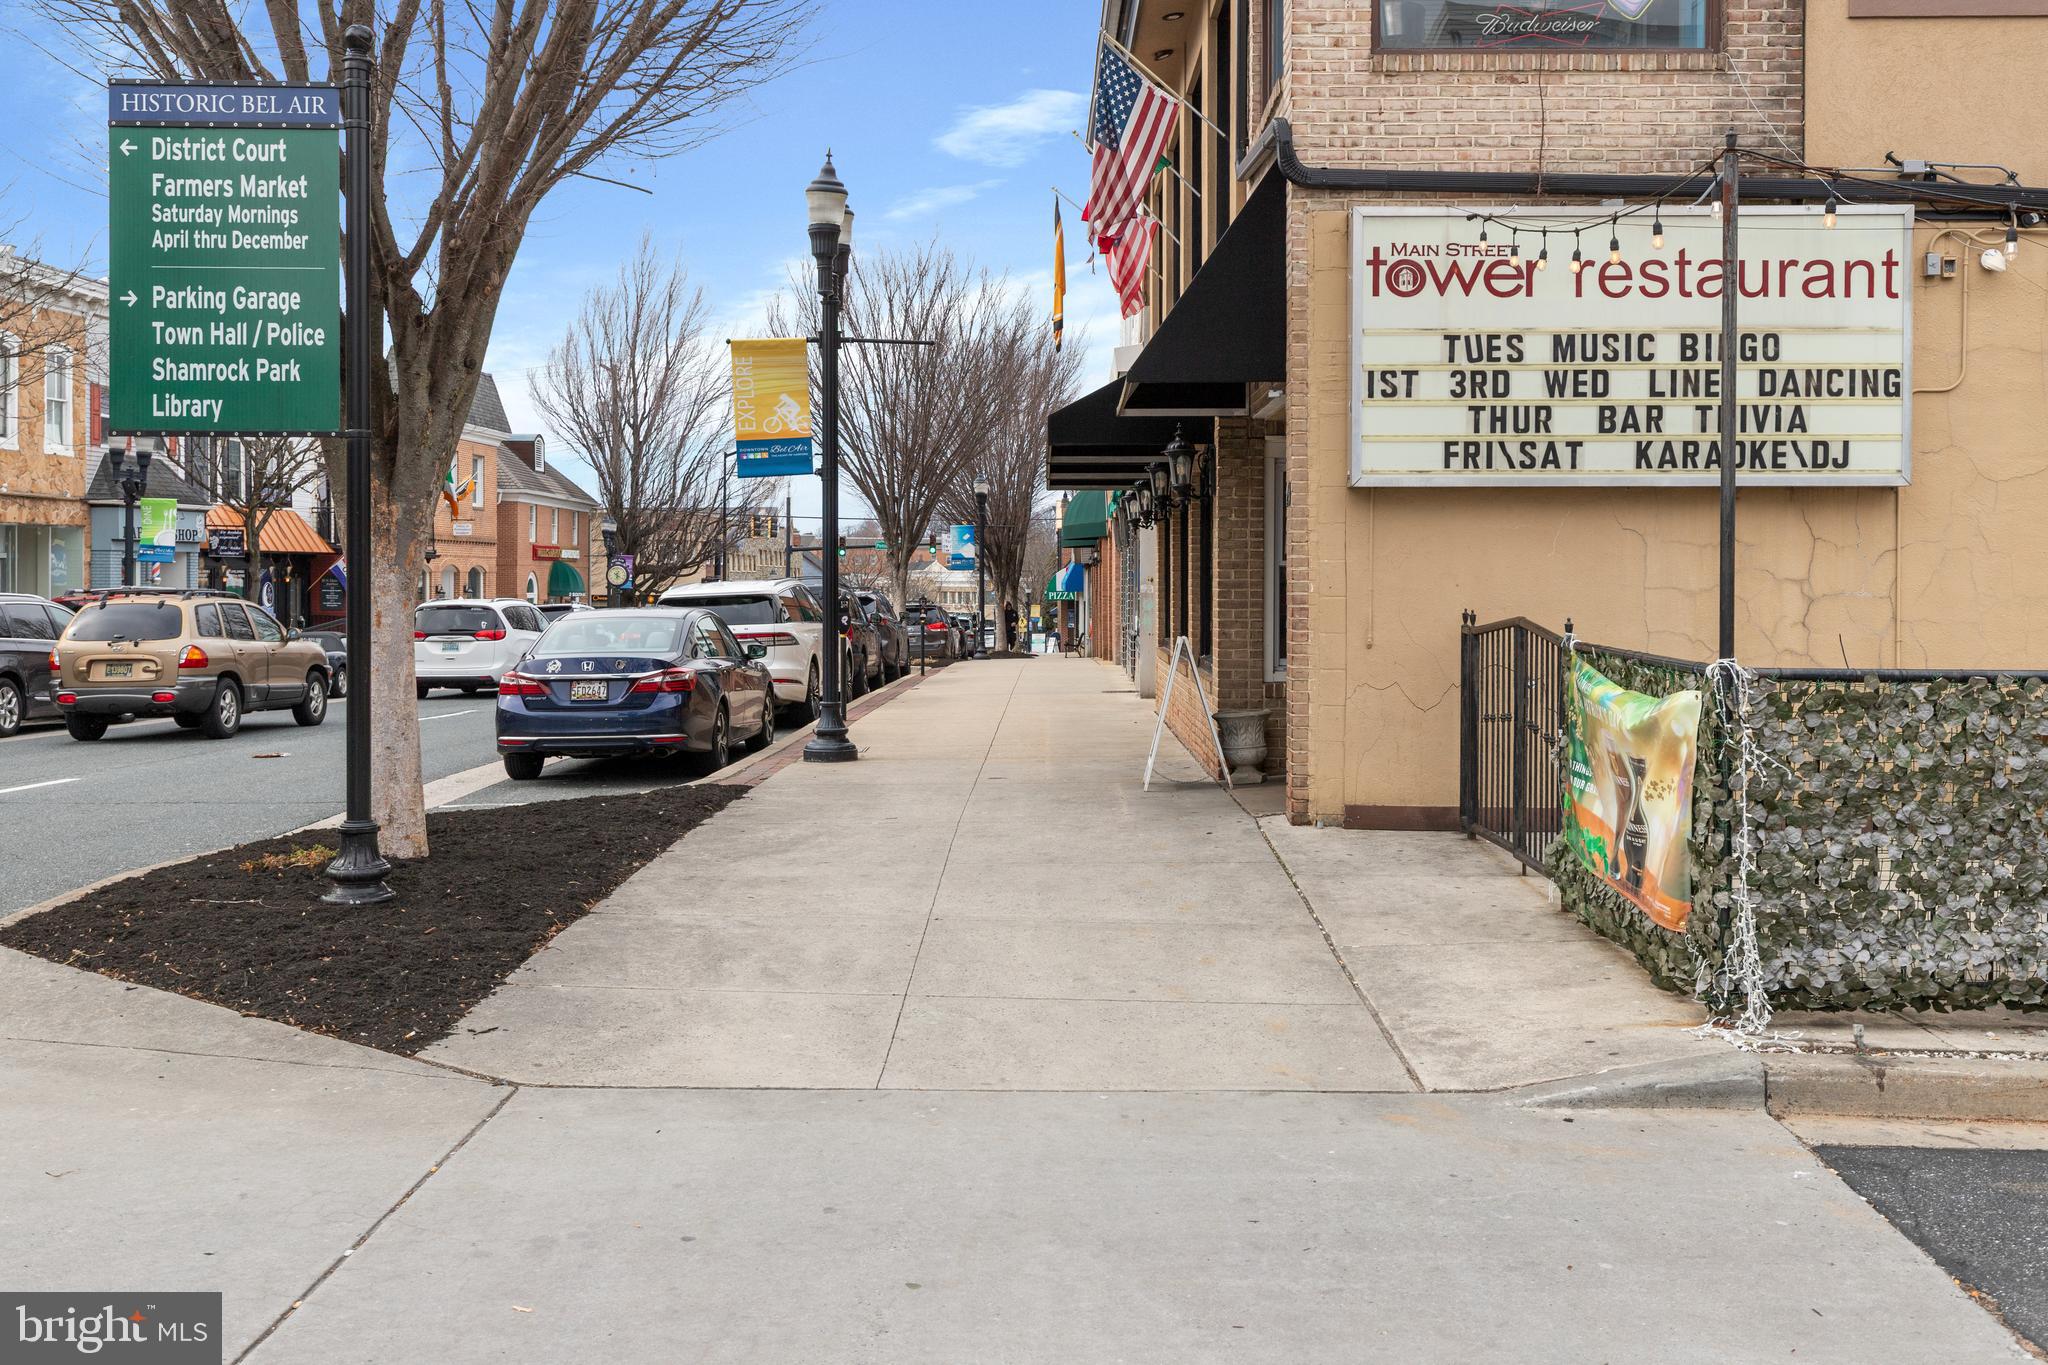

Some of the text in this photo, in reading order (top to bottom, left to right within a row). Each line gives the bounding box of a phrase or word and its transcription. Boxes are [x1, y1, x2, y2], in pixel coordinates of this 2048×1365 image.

[1475, 12, 1600, 36] Budweiser
[121, 93, 327, 114] HISTORIC BEL AIR
[152, 136, 286, 162] District Court
[152, 173, 308, 199] Farmers Market
[152, 204, 298, 228] Saturday Mornings
[152, 230, 308, 252] April thru December
[1366, 246, 1900, 299] tower restaurant
[152, 286, 301, 315] Parking Garage
[152, 321, 203, 345] Town
[210, 322, 247, 345] Hall
[267, 322, 325, 346] Police
[1443, 332, 1780, 363] TUES MUSIC BIGO
[152, 358, 301, 382] Shamrock Park
[735, 356, 756, 431] EXPLORE
[1450, 369, 1511, 398] 3RD
[1544, 369, 1610, 398] WED
[1649, 369, 1720, 398] LINE
[1758, 369, 1901, 398] DANCING
[152, 393, 223, 422] Library
[1468, 405, 1808, 434] THUR BAR TIVIA
[143, 505, 152, 525] DINE
[1048, 591, 1074, 600] PIZZA
